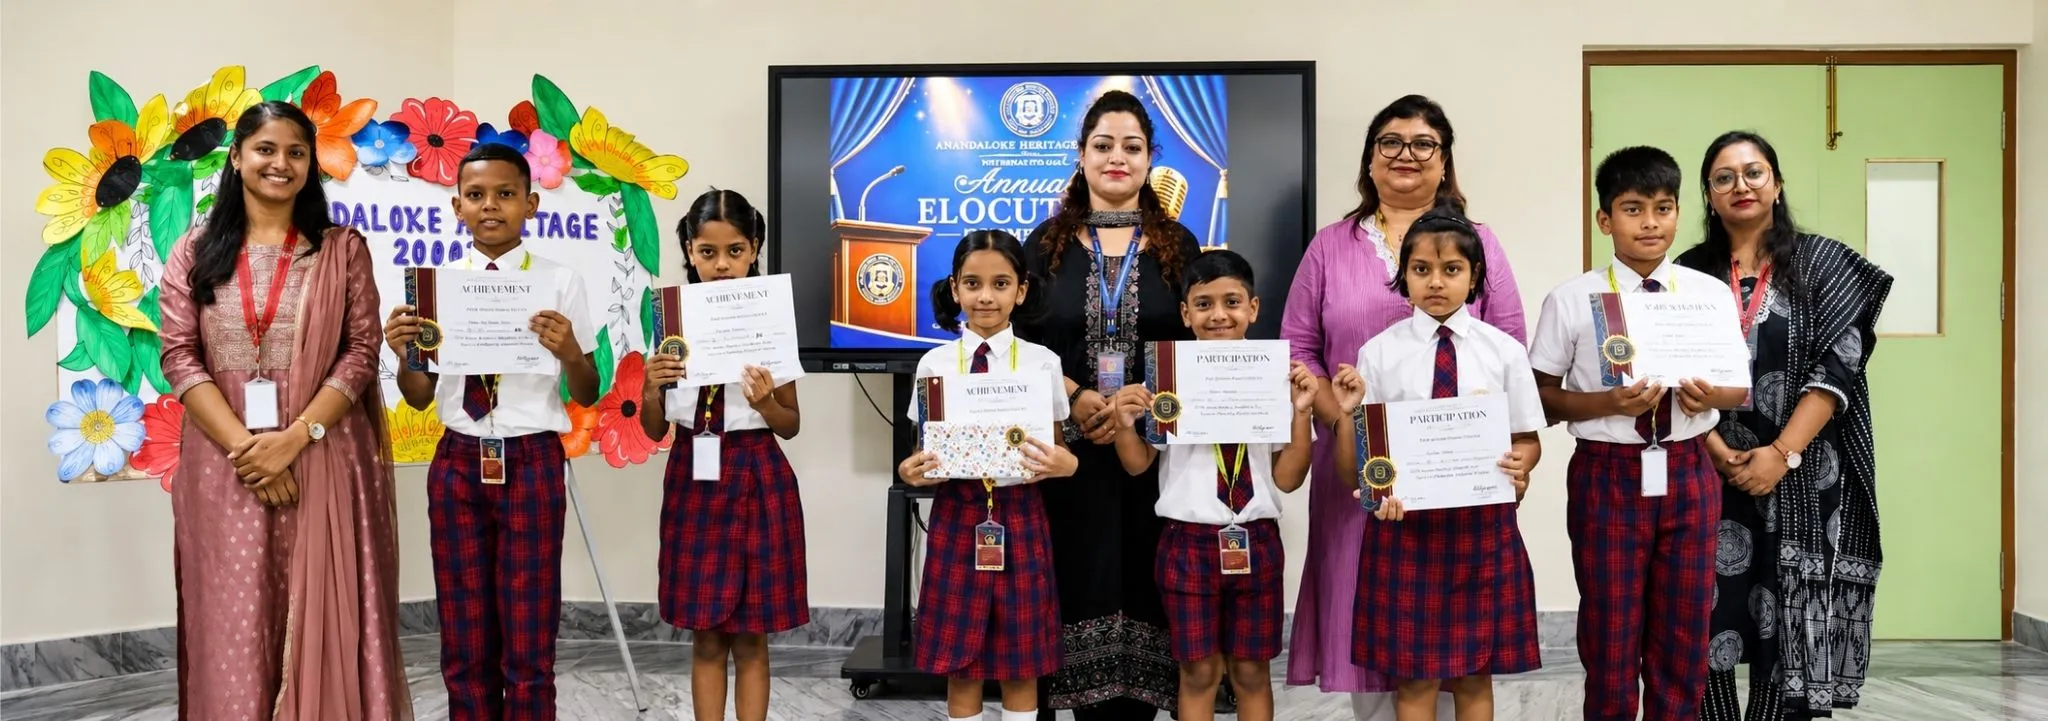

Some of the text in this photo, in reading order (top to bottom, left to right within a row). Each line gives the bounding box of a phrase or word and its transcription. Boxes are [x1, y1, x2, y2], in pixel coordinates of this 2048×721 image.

[936, 140, 1078, 150] ANANDALOKE HERITAGE
[461, 285, 532, 294] ACHIEVEMENT
[705, 290, 769, 304] ACHIEVEMENT
[1197, 354, 1271, 364] PARTICIPATION
[966, 385, 1028, 396] ACHIEVEMENT
[1409, 409, 1487, 425] PARTICIPATION
